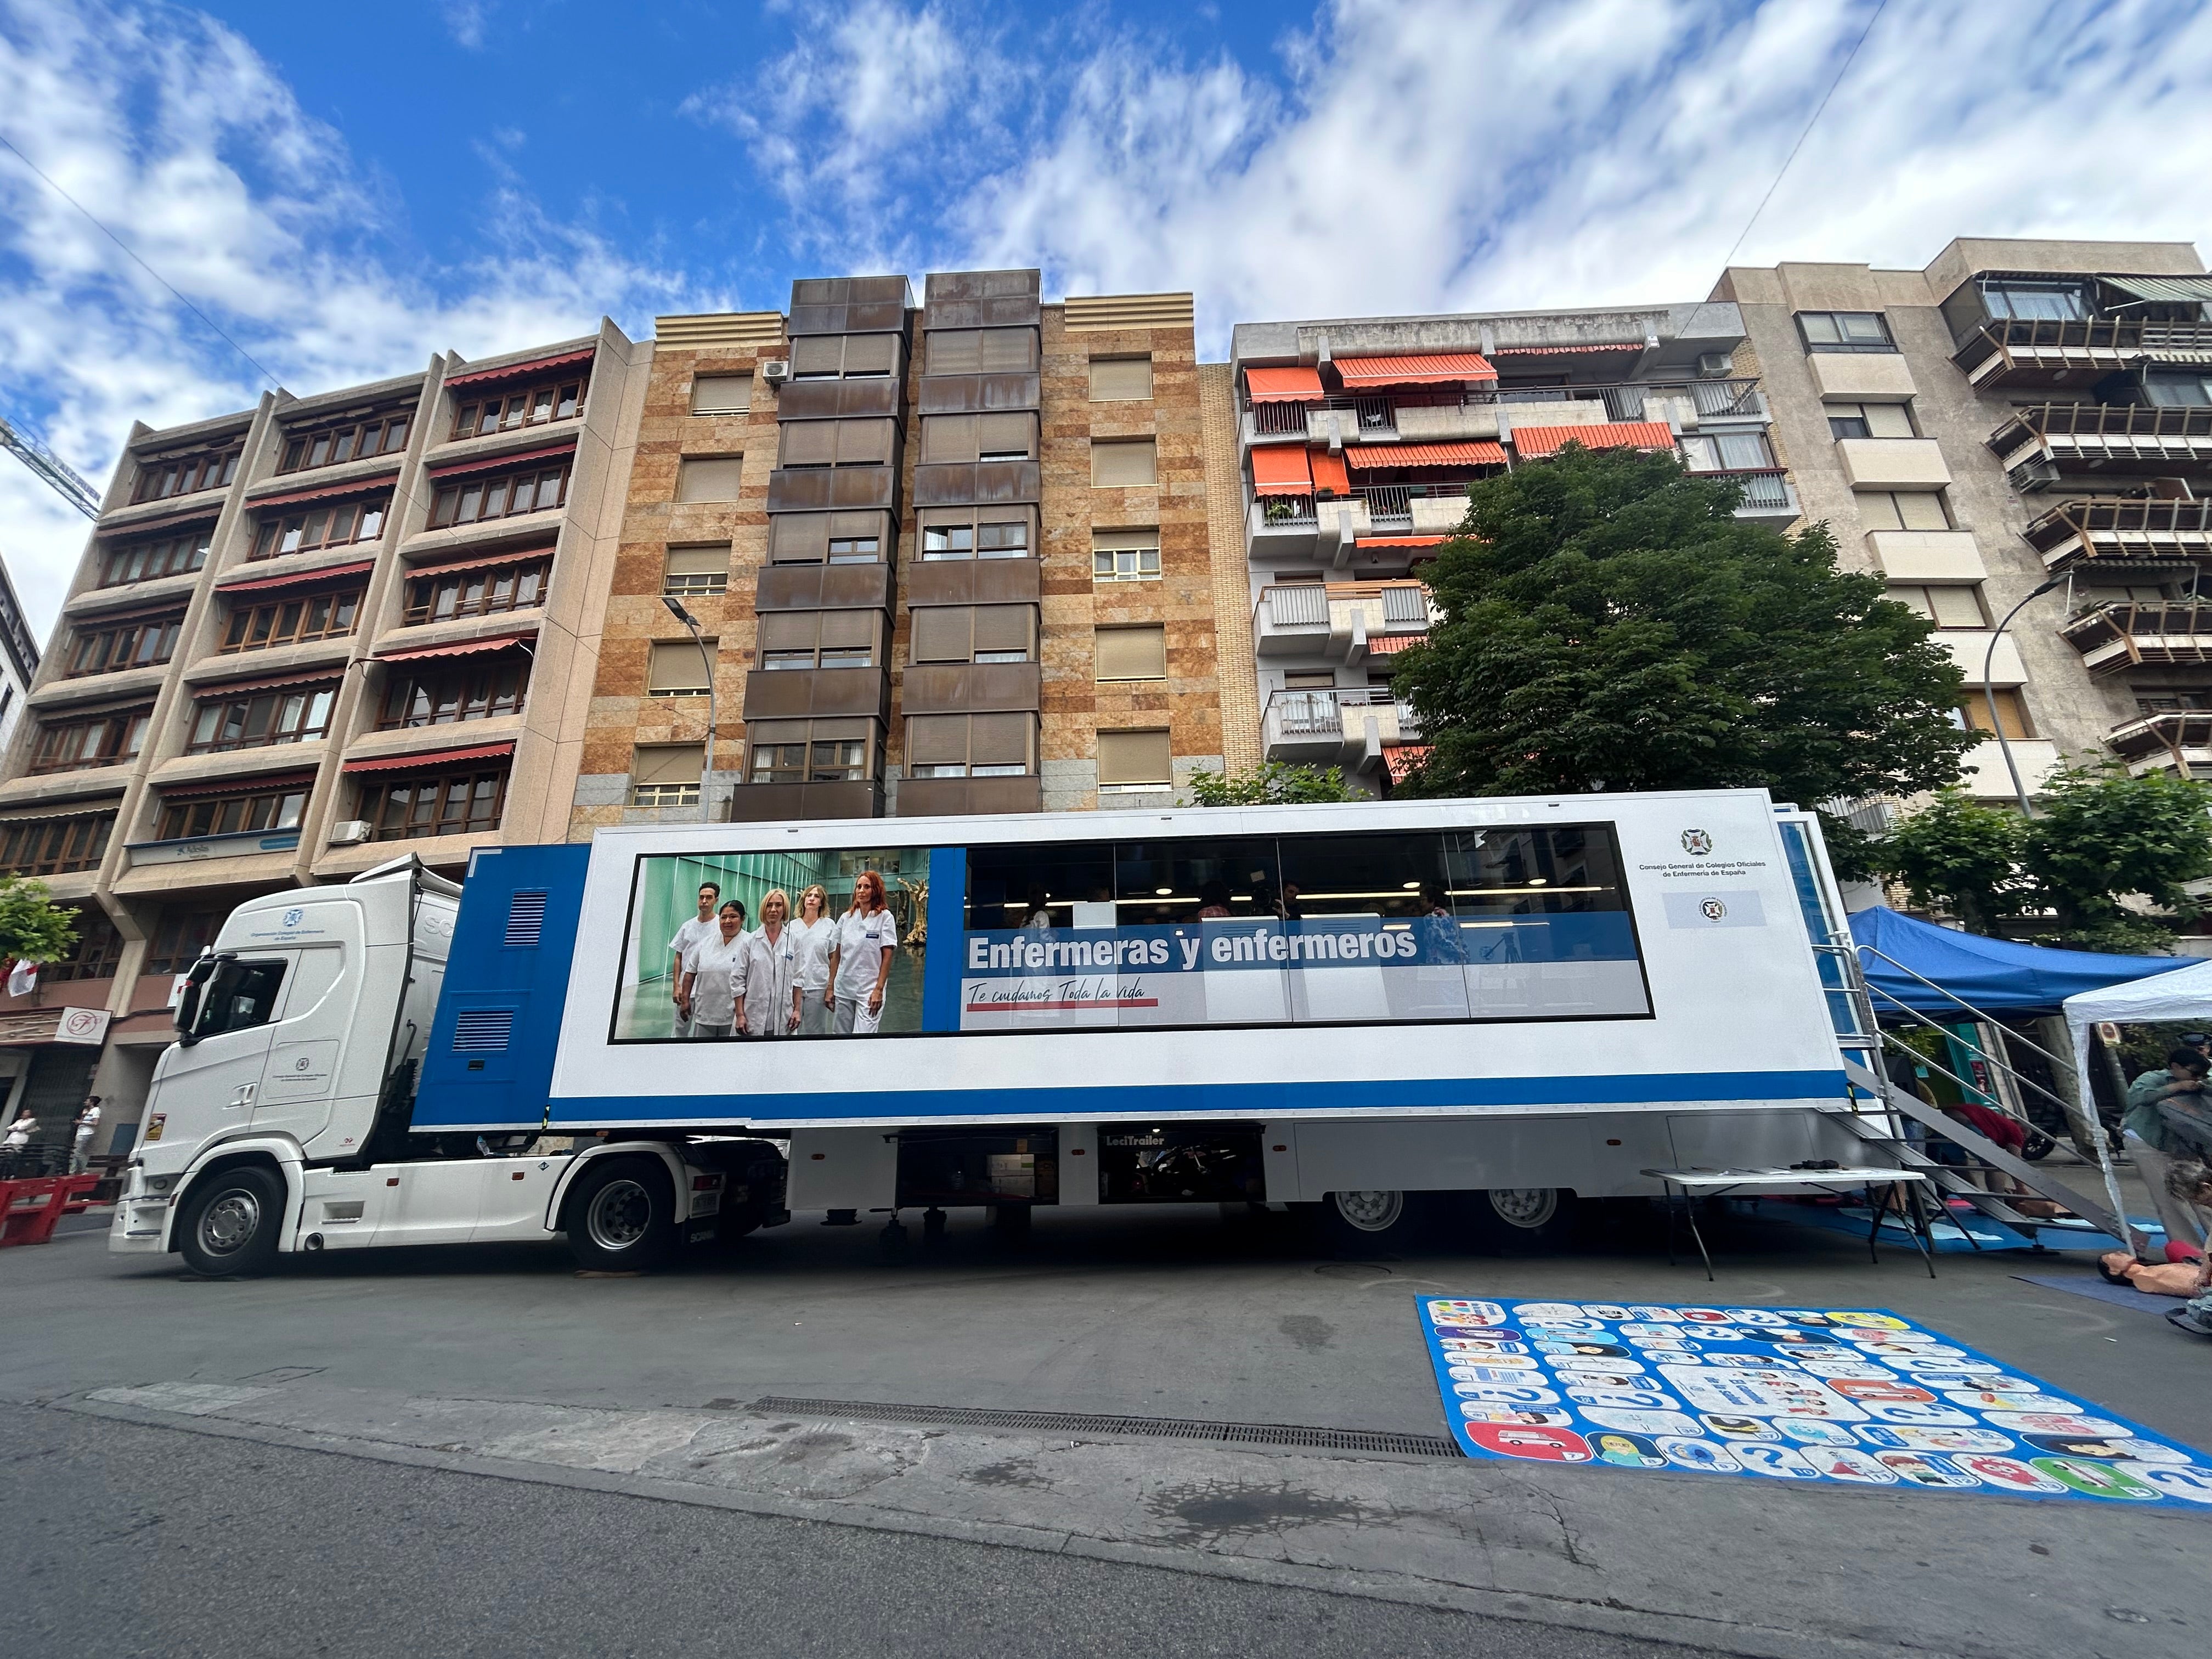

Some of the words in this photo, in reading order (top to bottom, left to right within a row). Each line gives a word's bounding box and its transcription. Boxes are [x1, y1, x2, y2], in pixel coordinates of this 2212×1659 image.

[969, 935, 1169, 969] Enfermeras
[1180, 938, 1200, 970] y
[1211, 928, 1417, 962] enfermeros
[969, 983, 986, 1009] Te
[992, 980, 1053, 1004] cuidamos
[1059, 978, 1091, 1006] Toda
[1095, 978, 1110, 1001] la
[1116, 977, 1145, 1005] vida
[1107, 1135, 1165, 1146] LeciTrailer
